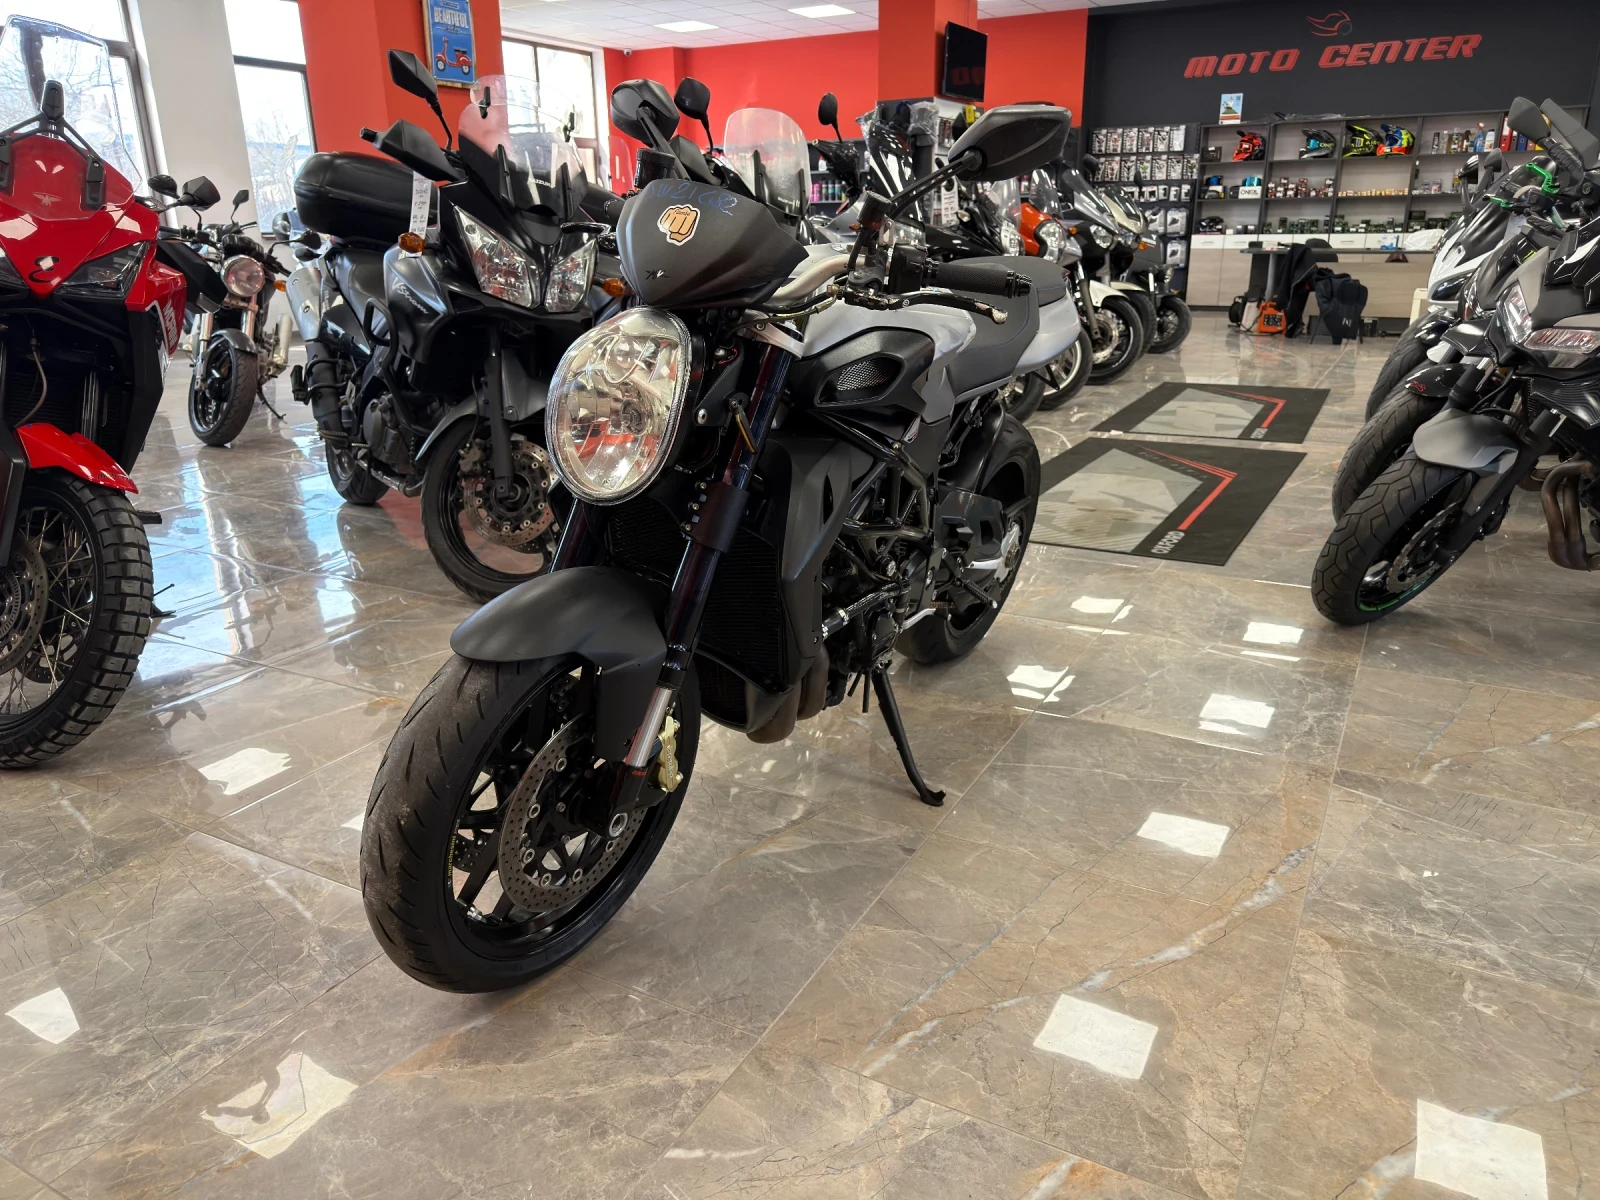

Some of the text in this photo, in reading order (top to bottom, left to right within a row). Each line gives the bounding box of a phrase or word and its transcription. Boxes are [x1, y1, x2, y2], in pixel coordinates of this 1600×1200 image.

[1184, 34, 1482, 78] MOTO CENTER
[1150, 530, 1186, 554] OXFORD
[447, 835, 457, 877] marchesini
